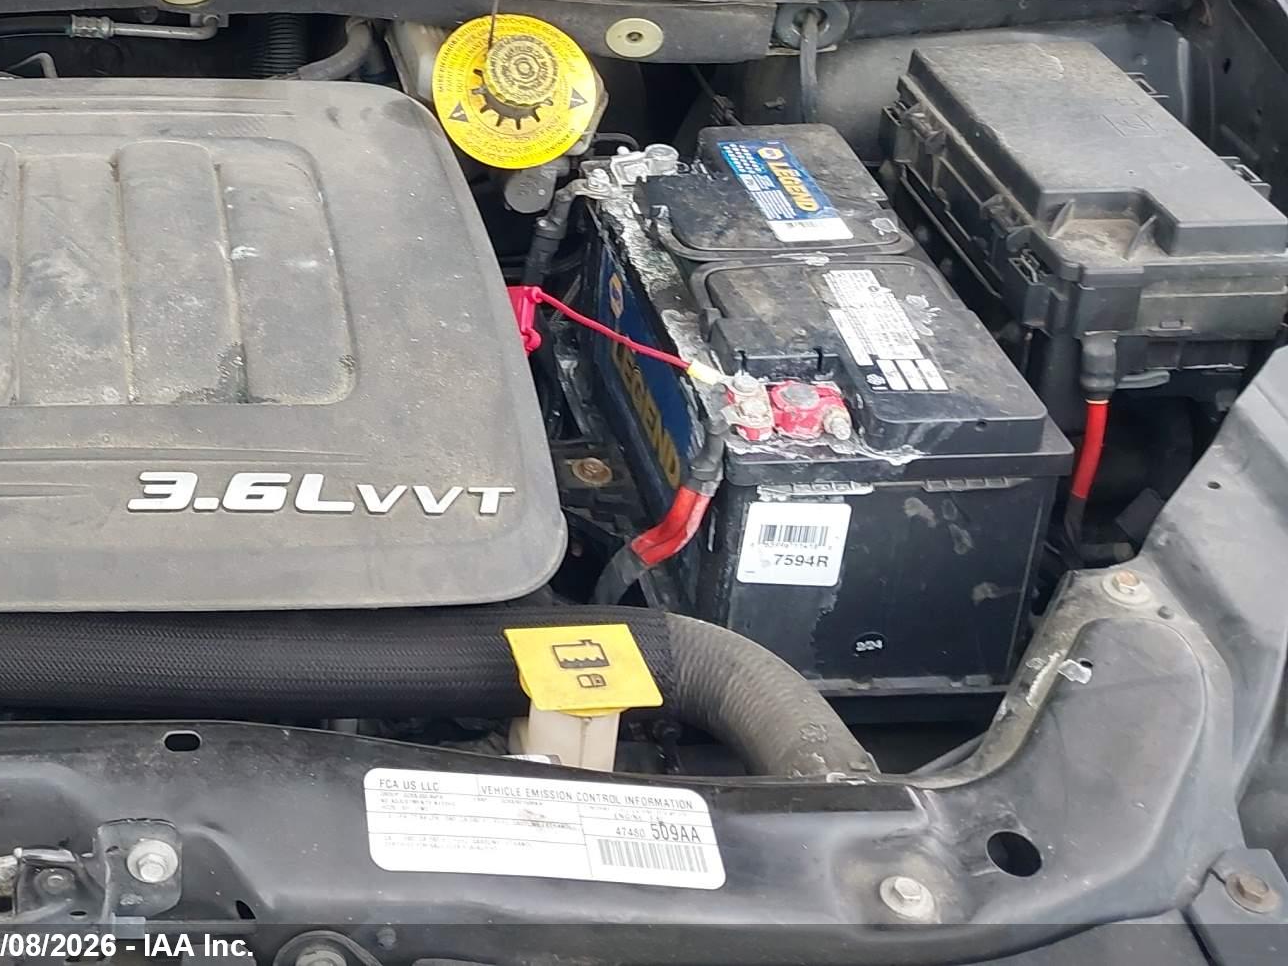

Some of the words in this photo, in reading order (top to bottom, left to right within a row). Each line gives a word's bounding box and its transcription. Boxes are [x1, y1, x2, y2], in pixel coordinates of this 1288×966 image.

[766, 161, 820, 212] LEGEND
[774, 554, 829, 567] 7594R
[379, 779, 399, 789] FCA
[403, 780, 416, 790] US
[420, 781, 440, 791] LLC
[481, 785, 521, 797] VEHICLE
[526, 788, 572, 801] EMISSION
[576, 792, 621, 805] CONTROL
[625, 795, 694, 810] INFORMATION
